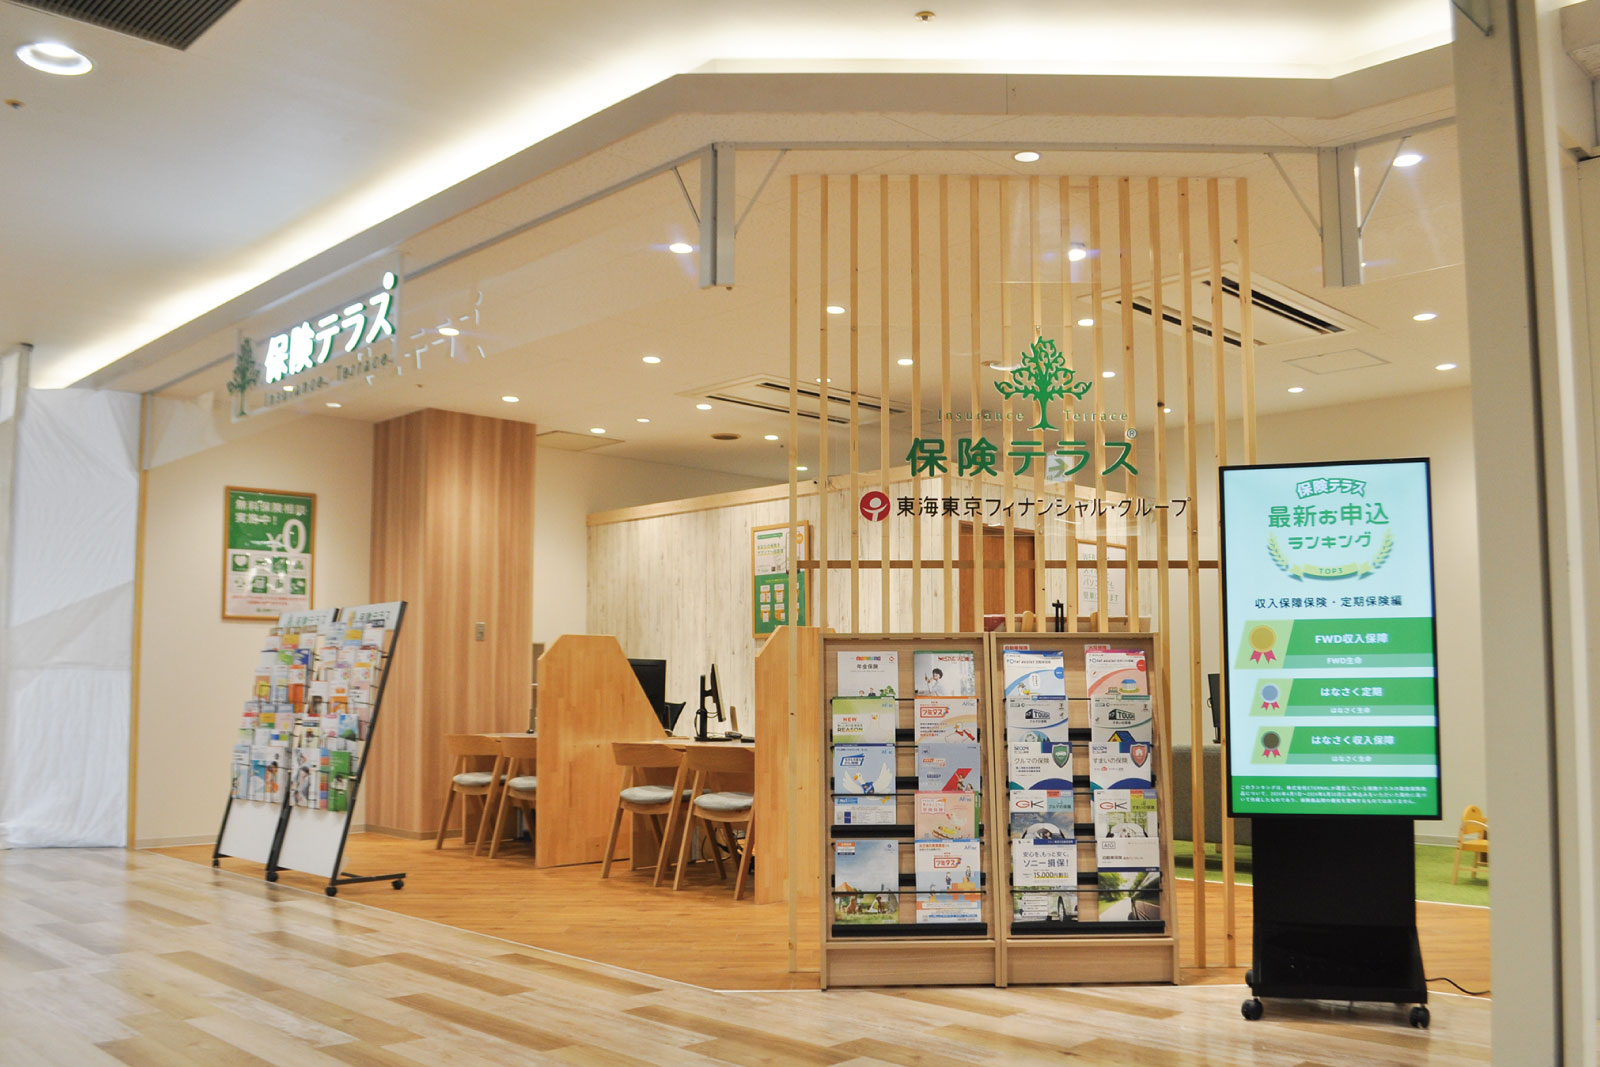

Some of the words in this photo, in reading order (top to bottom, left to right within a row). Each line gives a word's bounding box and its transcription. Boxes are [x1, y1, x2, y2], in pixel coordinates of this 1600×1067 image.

[264, 288, 397, 384] 保険テラス
[937, 409, 1024, 421] Insurance
[1064, 410, 1129, 421] Terrace
[906, 437, 1138, 477] 保険テラス
[1295, 477, 1367, 499] 保険テラス
[896, 496, 1192, 518] 東海東京フィナンシャル・グループ
[1268, 503, 1390, 528] 最新お申込
[1288, 532, 1372, 549] ランキング
[1319, 567, 1344, 575] TOP3
[1255, 595, 1403, 609] 収入保障保険・定期保険編
[1315, 633, 1389, 644] FWD収入保障
[1321, 687, 1382, 697] はなさく定期
[1311, 736, 1395, 745] はなさく収入保障
[1016, 800, 1044, 808] GK
